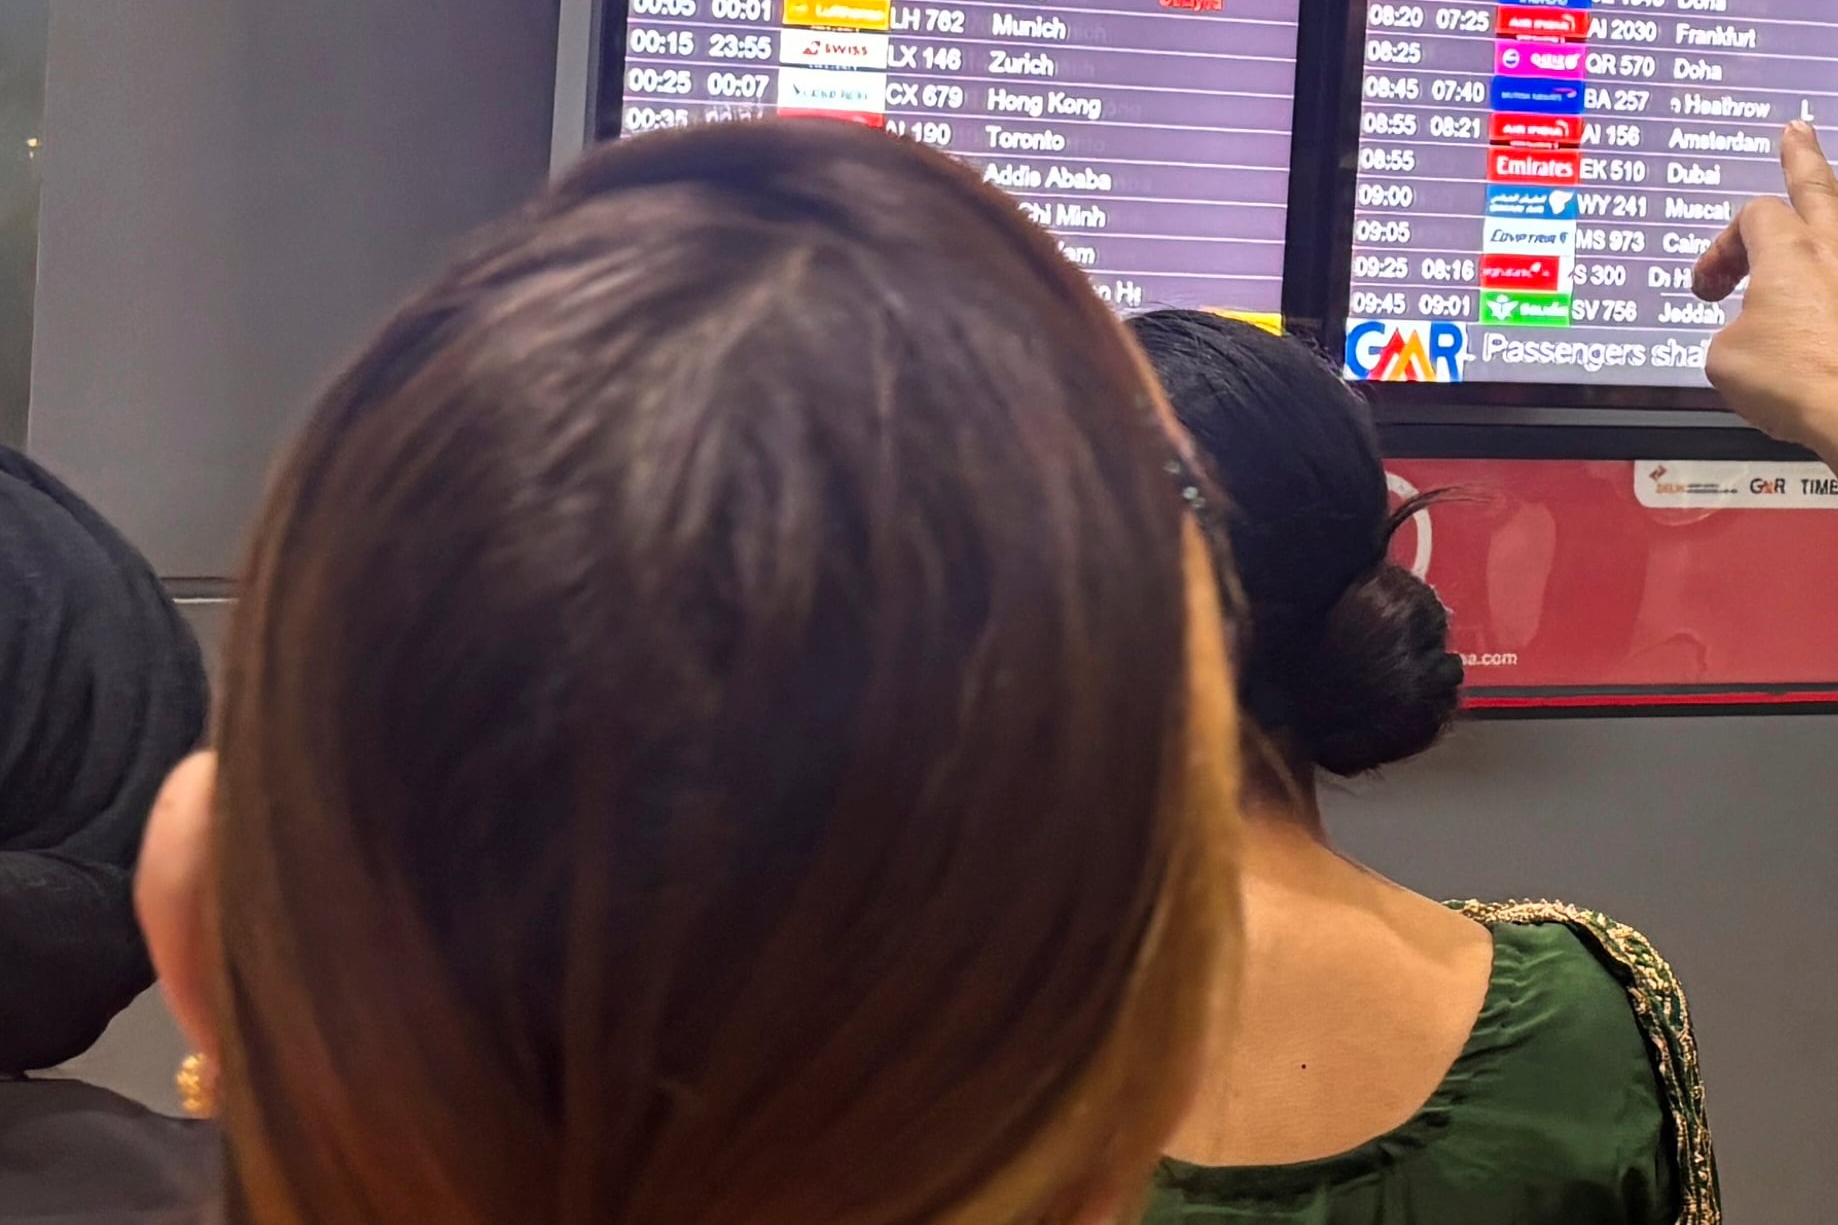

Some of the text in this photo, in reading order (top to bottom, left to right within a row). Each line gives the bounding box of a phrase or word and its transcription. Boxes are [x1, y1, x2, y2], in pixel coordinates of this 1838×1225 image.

[890, 7, 920, 30] LH
[992, 13, 1066, 39] Munich
[1431, 79, 1484, 102] 07:40
[1585, 88, 1611, 109] BA
[1613, 89, 1649, 110] 257
[1684, 93, 1770, 118] Heathrow
[1495, 154, 1720, 184] Emirates EK 510 Dubai
[1577, 193, 1611, 214] WY
[1612, 194, 1646, 216] 241
[1345, 319, 1467, 383] GMR
[1482, 331, 1647, 372] Passengers
